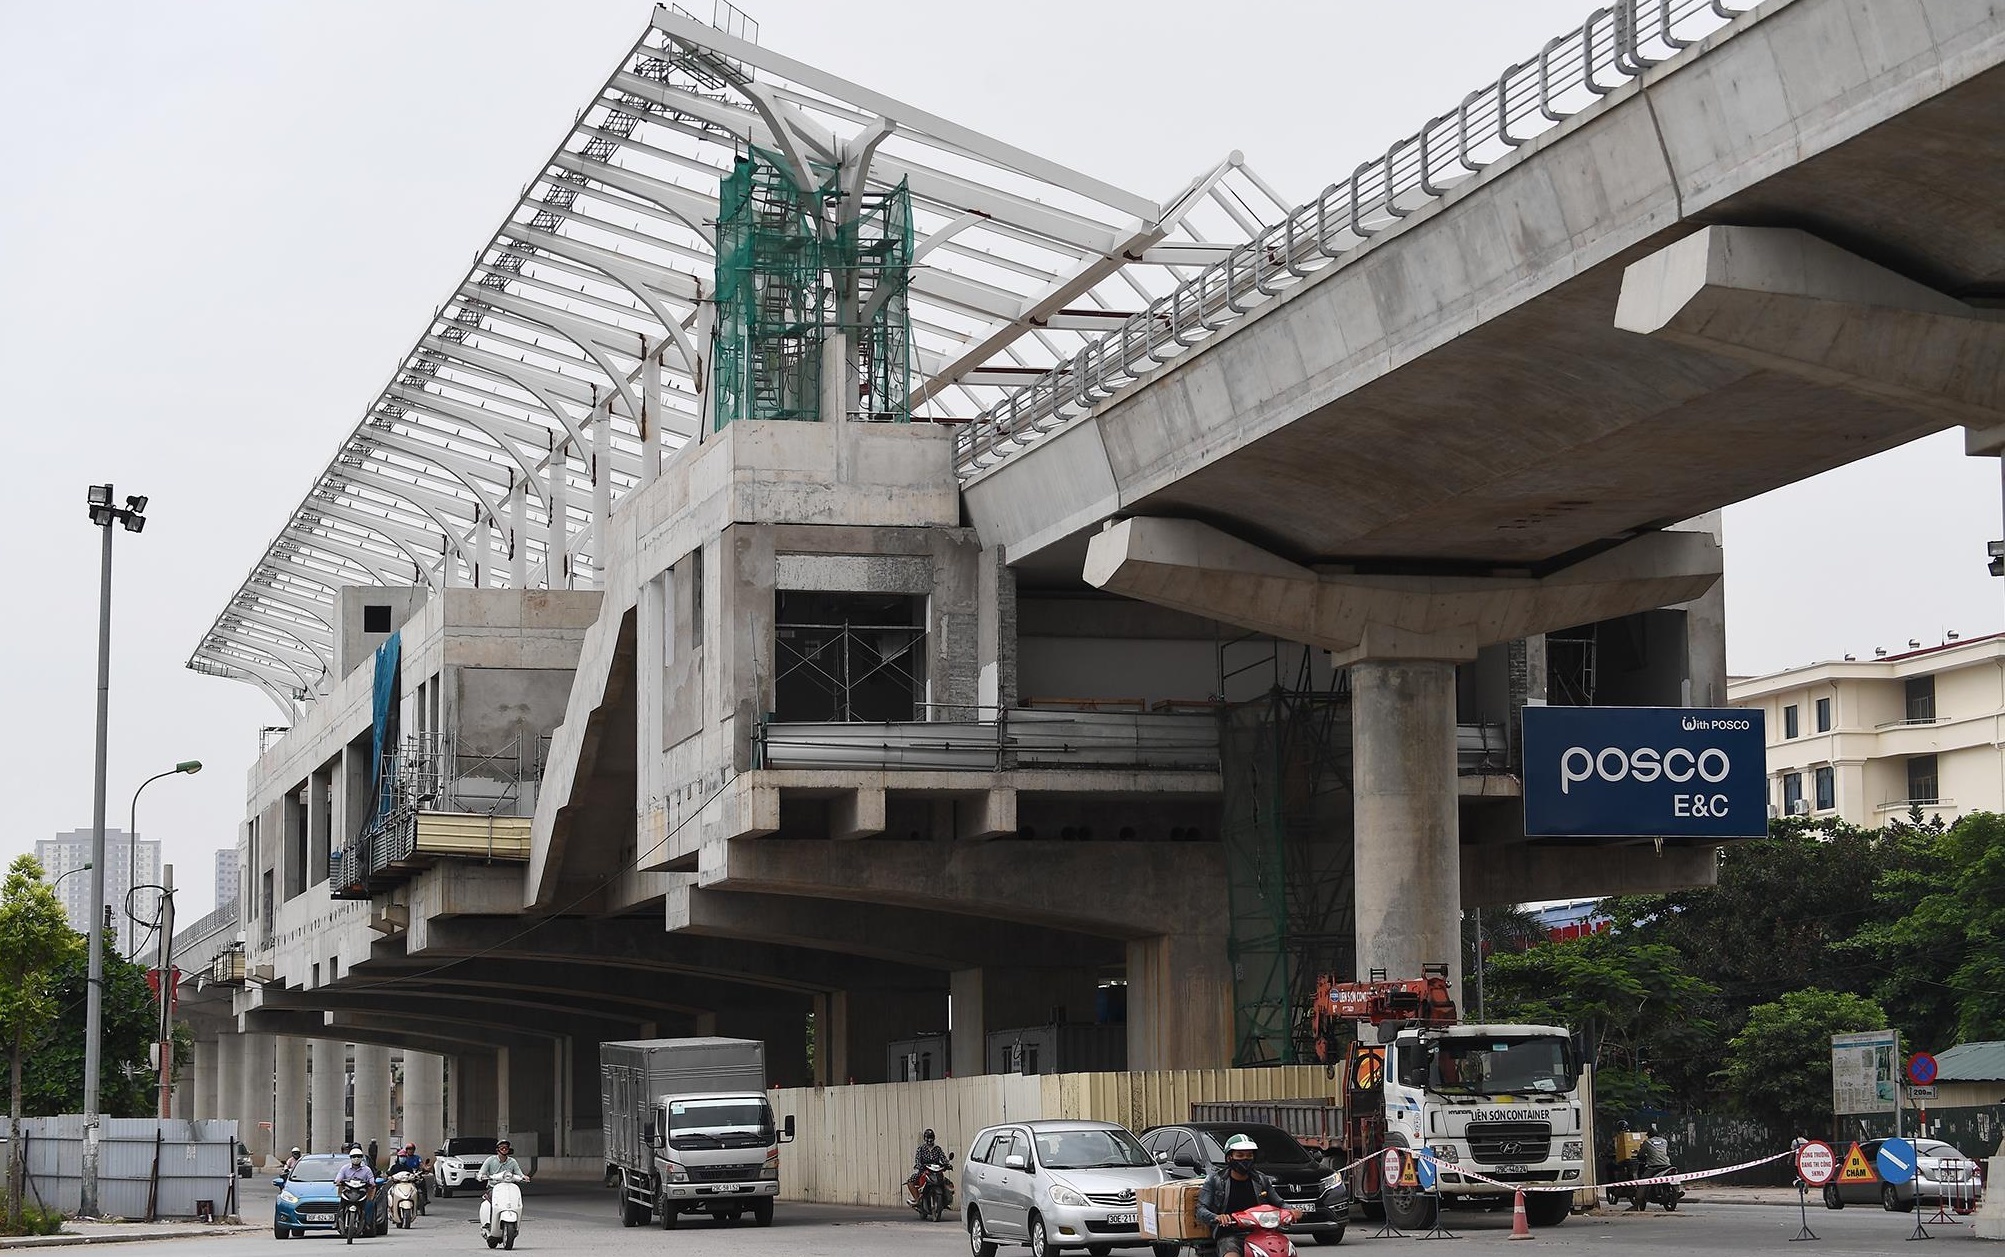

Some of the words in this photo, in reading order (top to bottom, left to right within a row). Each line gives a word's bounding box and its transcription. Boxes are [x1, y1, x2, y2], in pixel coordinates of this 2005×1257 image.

[1682, 716, 1710, 731] With
[1711, 720, 1750, 730] POSCO
[1674, 794, 1729, 817] E&C
[1913, 1087, 1932, 1096] 200m
[1506, 1109, 1550, 1121] CONTAINER
